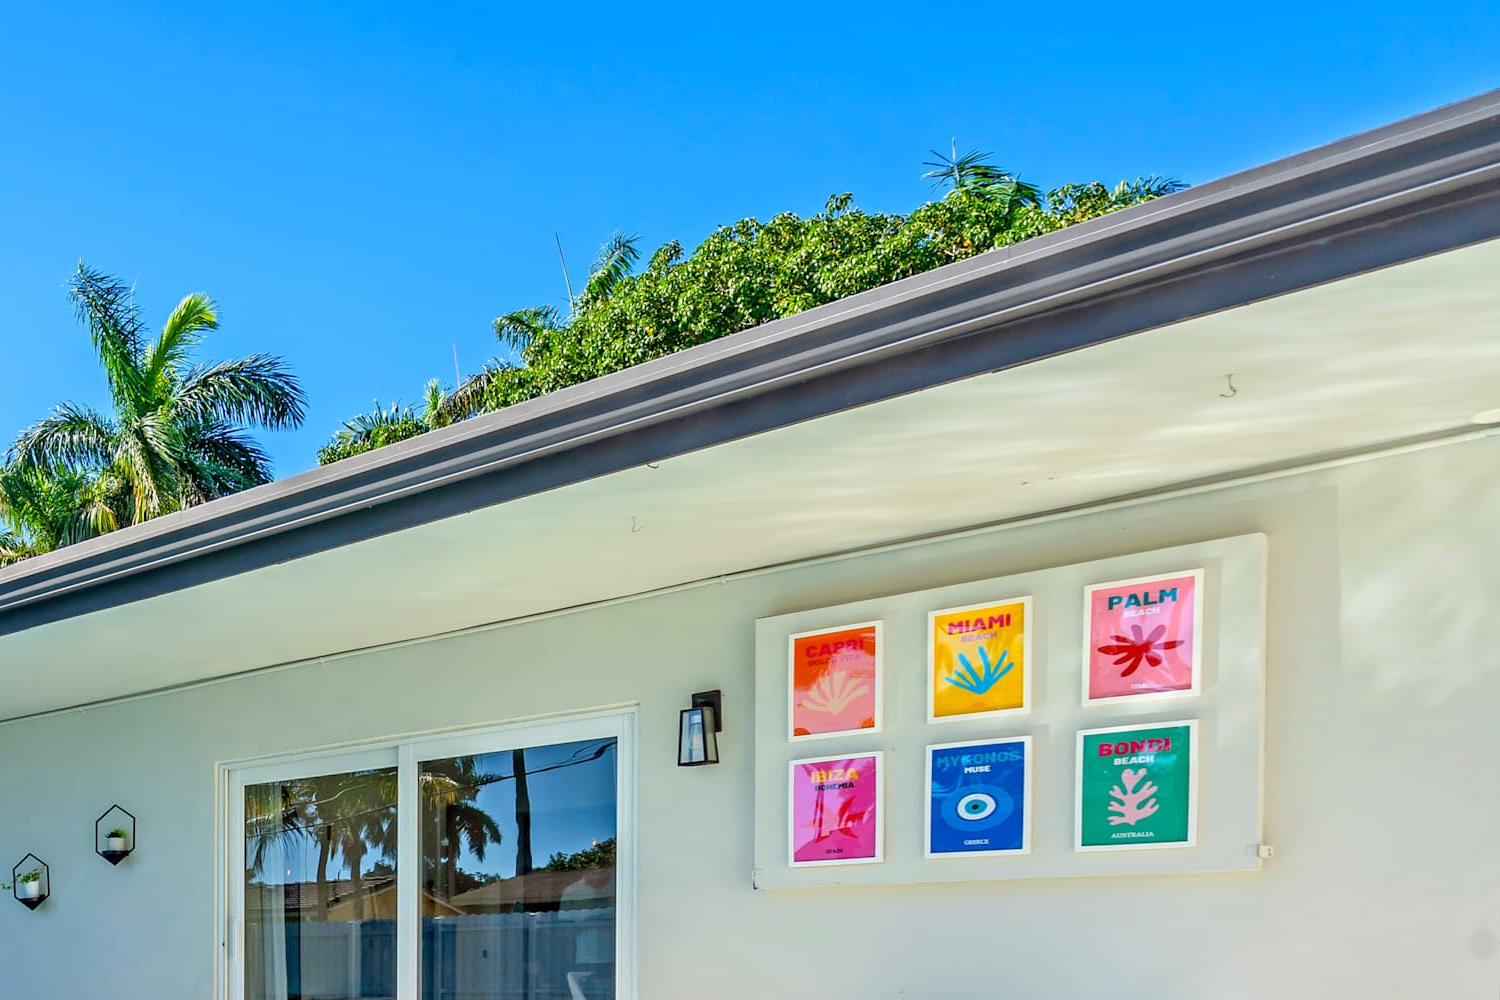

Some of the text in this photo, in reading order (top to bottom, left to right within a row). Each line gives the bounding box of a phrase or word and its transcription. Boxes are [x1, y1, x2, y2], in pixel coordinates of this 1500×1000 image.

[1108, 587, 1178, 611] PALM
[1124, 607, 1160, 618] BEACH
[948, 614, 1011, 635] MIAMI
[961, 632, 997, 643] BEACH
[806, 639, 864, 658] CAPRI
[1098, 738, 1171, 757] BONDI
[1114, 755, 1154, 765] BEACH
[811, 768, 859, 784] IBIZA
[964, 765, 991, 774] MUSE
[815, 782, 854, 792] BOHEMIA
